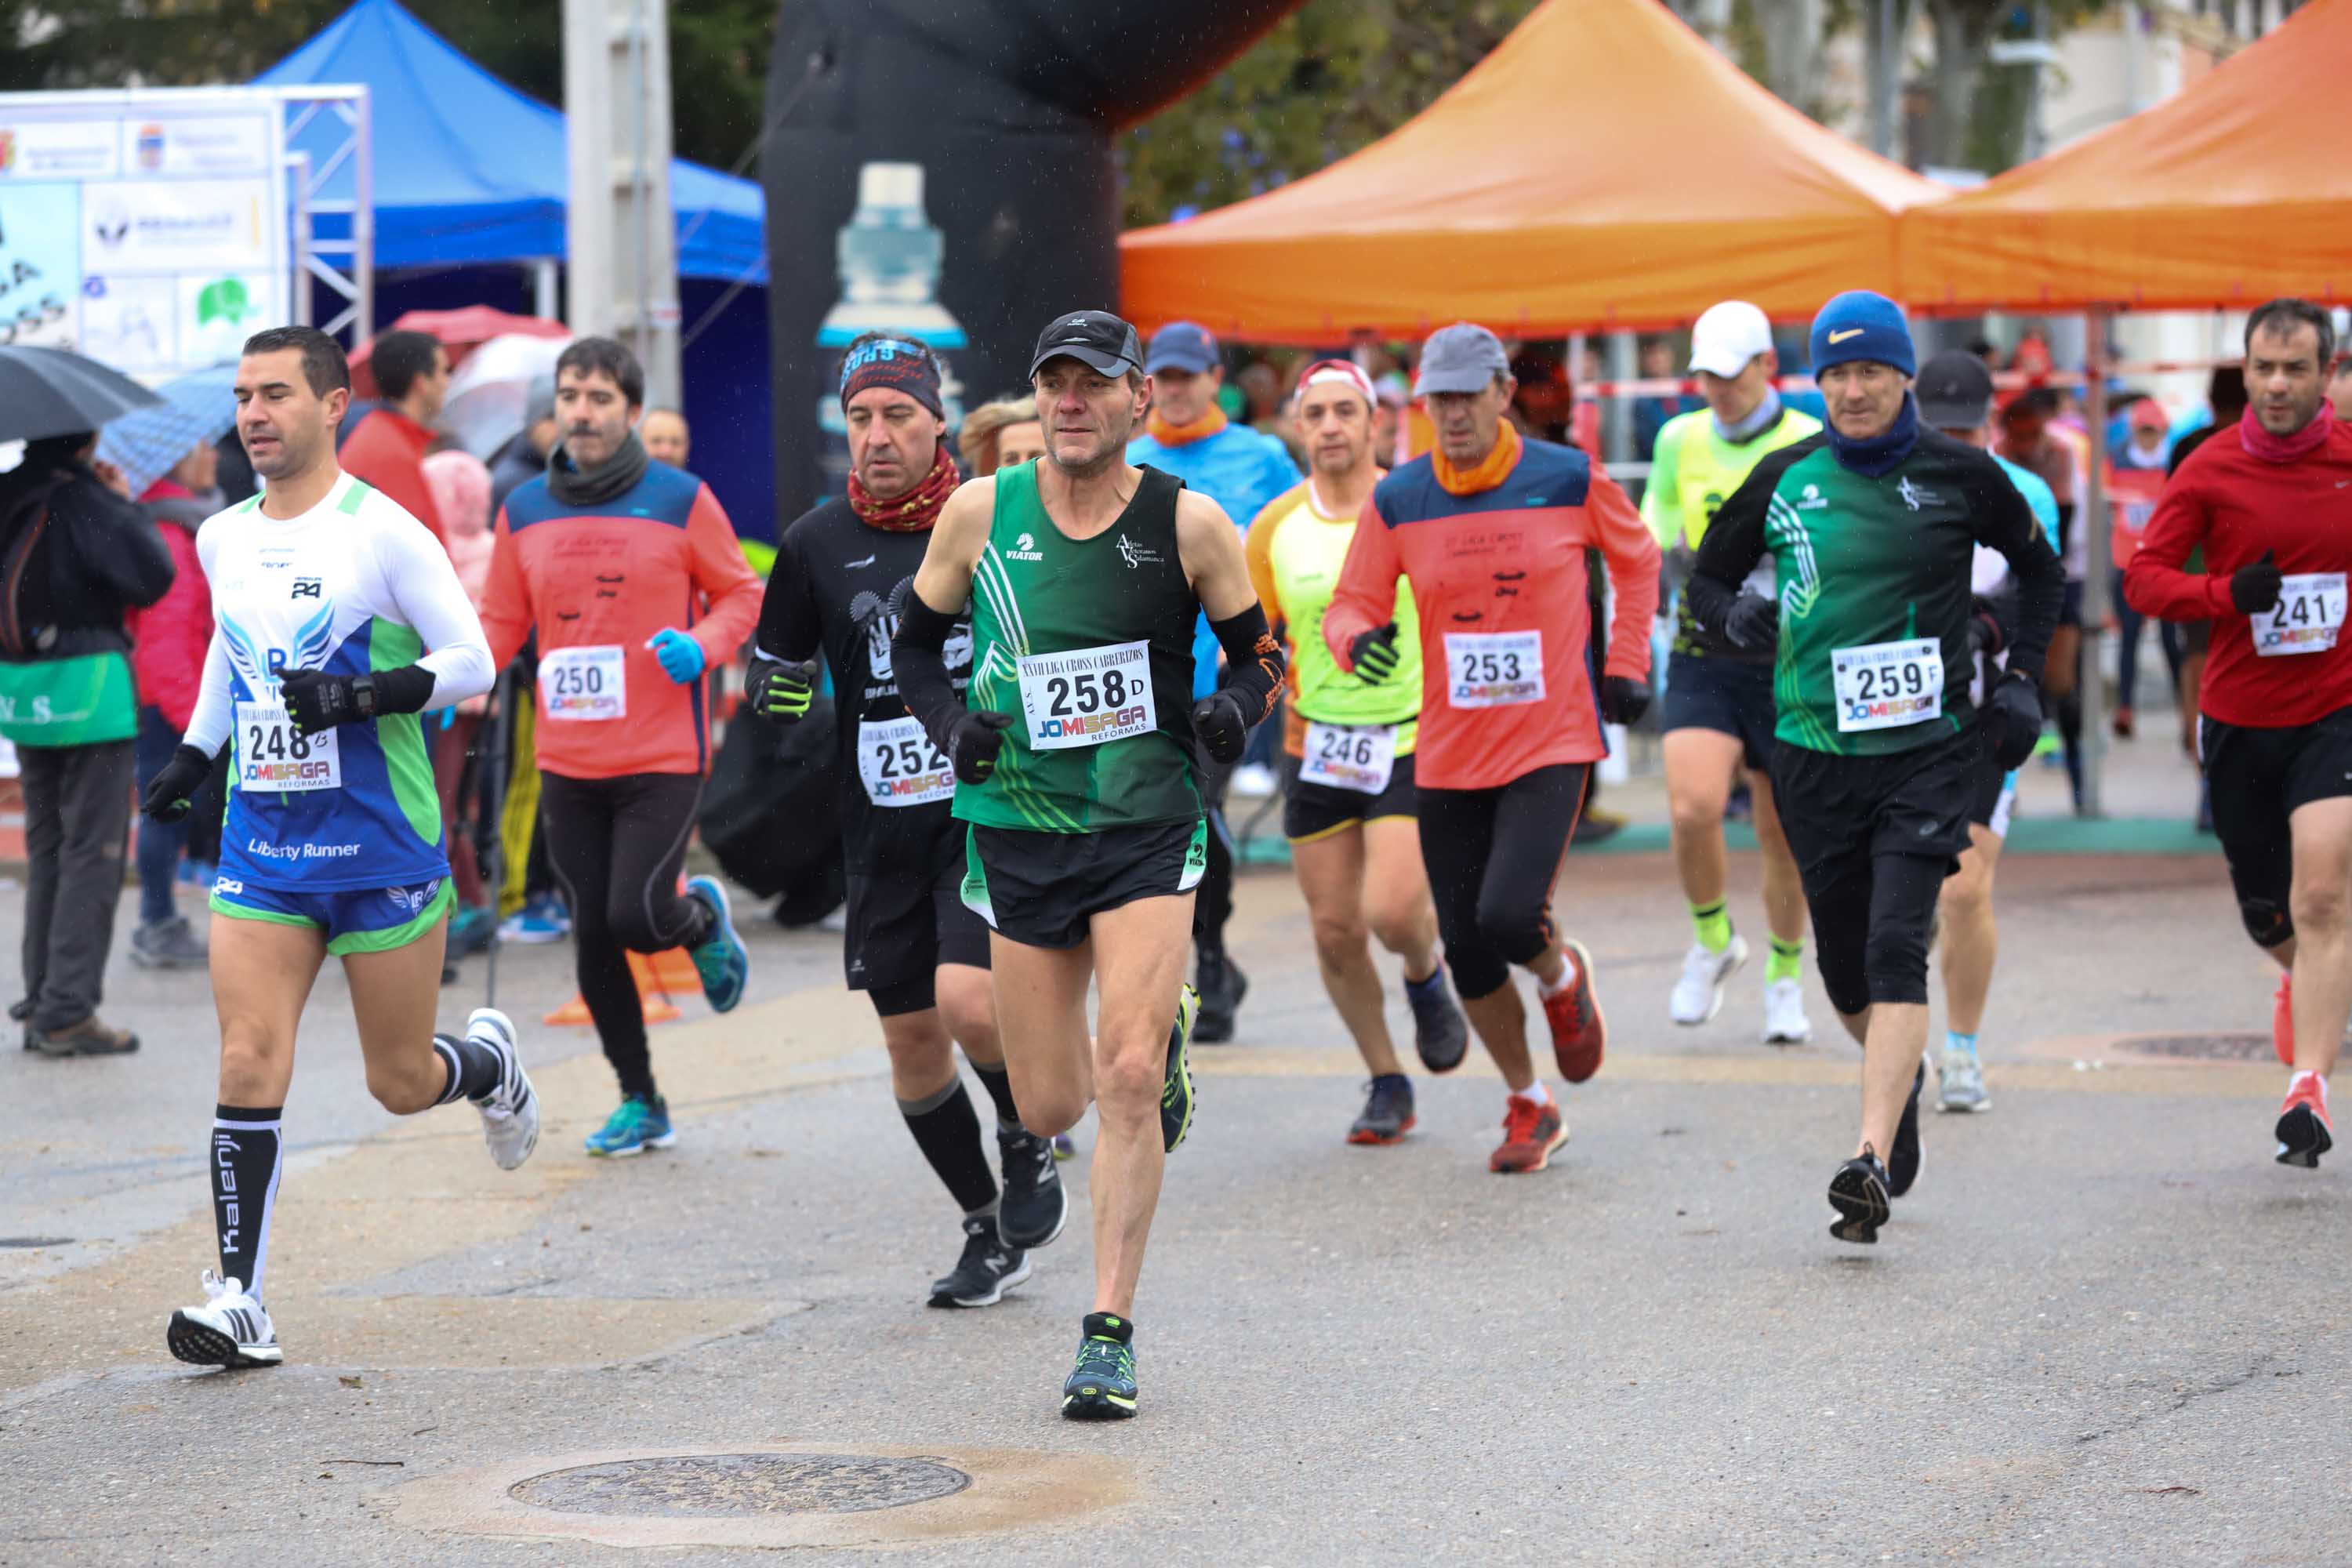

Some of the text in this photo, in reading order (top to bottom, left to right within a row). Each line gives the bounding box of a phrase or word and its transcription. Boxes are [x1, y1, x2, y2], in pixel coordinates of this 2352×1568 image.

[1006, 550, 1043, 561] VIATOR
[291, 582, 321, 599] 24
[2274, 593, 2326, 627] 241
[1046, 660, 1065, 675] LIGA
[1066, 657, 1092, 673] CROSS
[1094, 648, 1143, 670] CABRERIZOS
[1464, 653, 1521, 682] 253
[554, 667, 603, 694] 250
[1047, 670, 1126, 717] 258
[1131, 679, 1144, 695] D
[1857, 662, 1922, 700] 259
[1038, 706, 1147, 739] JOMISAGA
[1091, 723, 1147, 741] REFORMAS
[250, 725, 310, 760] 248
[1321, 732, 1372, 764] 246
[877, 741, 948, 778] 252
[278, 779, 330, 788] REFORMAS
[248, 838, 361, 861] Liberty Runner
